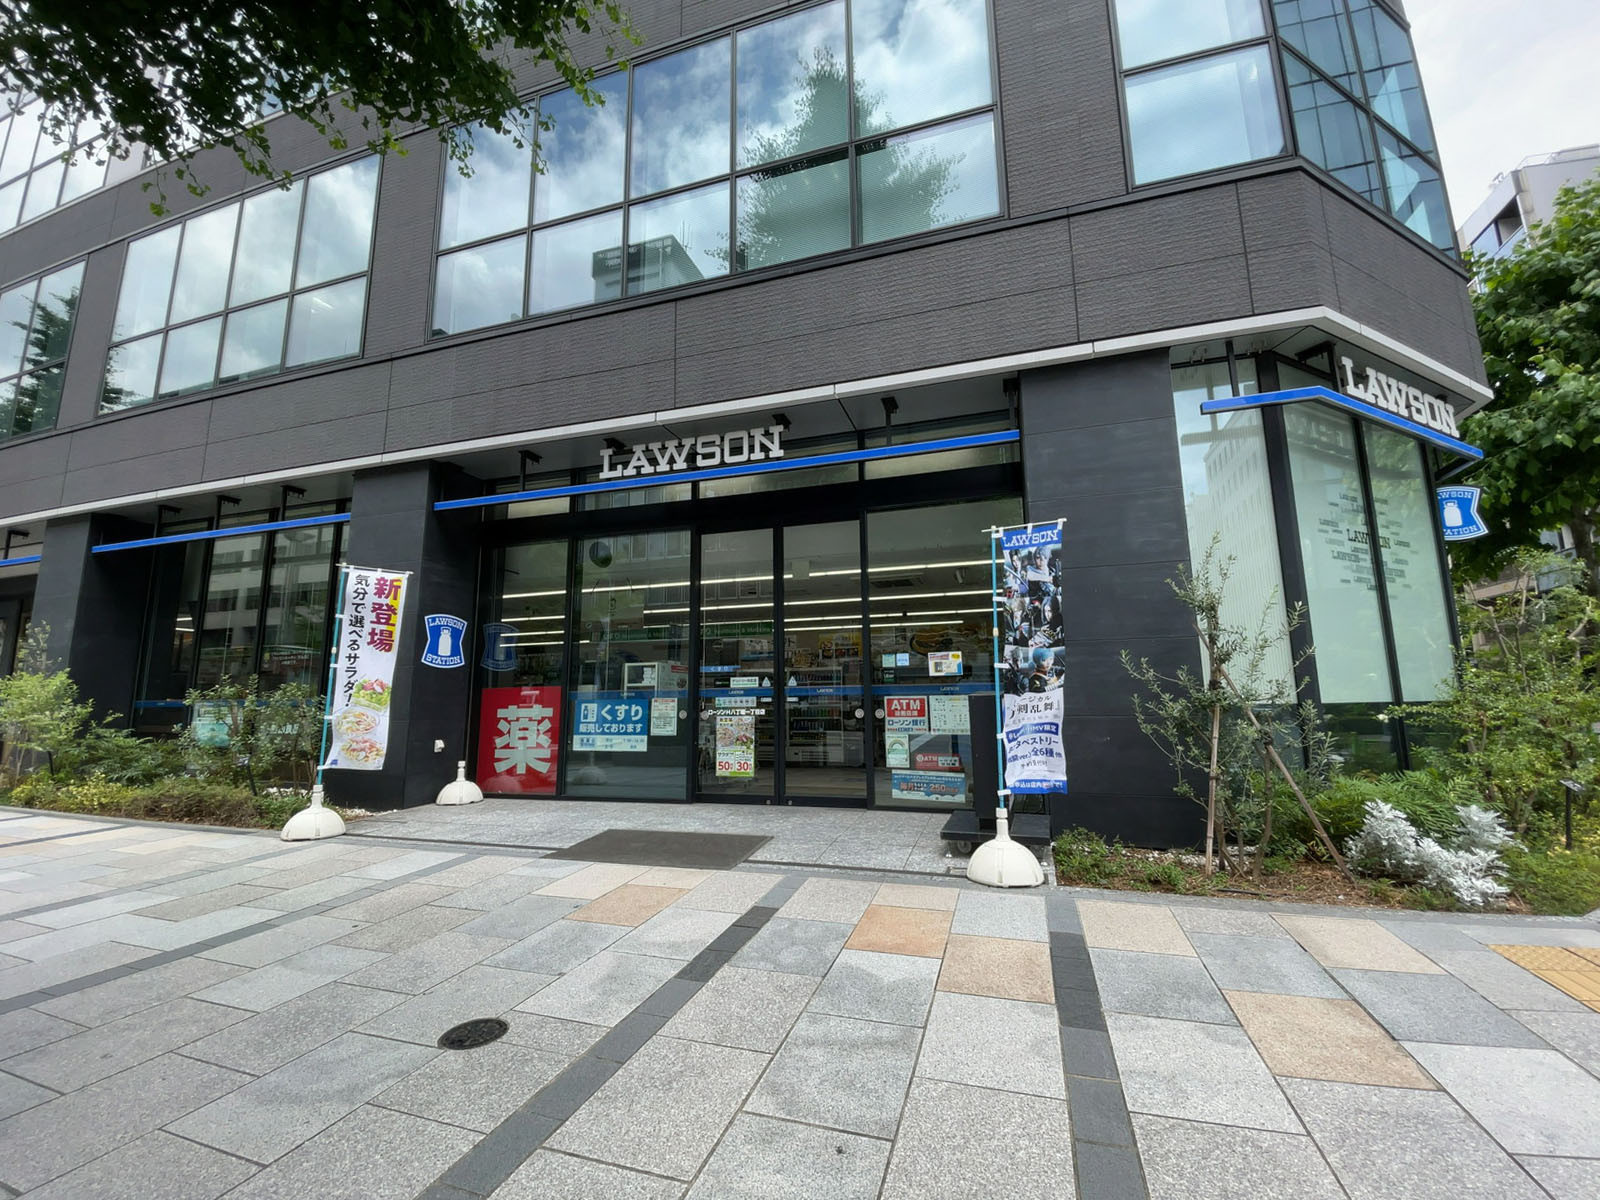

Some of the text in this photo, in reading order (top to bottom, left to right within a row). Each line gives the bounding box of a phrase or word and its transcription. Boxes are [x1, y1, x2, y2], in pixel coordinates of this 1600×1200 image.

[1341, 356, 1460, 438] LAWSON
[599, 425, 784, 479] LAWSON
[1002, 529, 1059, 547] LAWSON
[367, 576, 401, 653] 新登場
[428, 617, 464, 630] LAWSON
[425, 653, 460, 665] STATION
[601, 704, 643, 721] くすり
[891, 699, 920, 710] ATM
[579, 723, 643, 733] 販売しております
[493, 704, 554, 774] 薬
